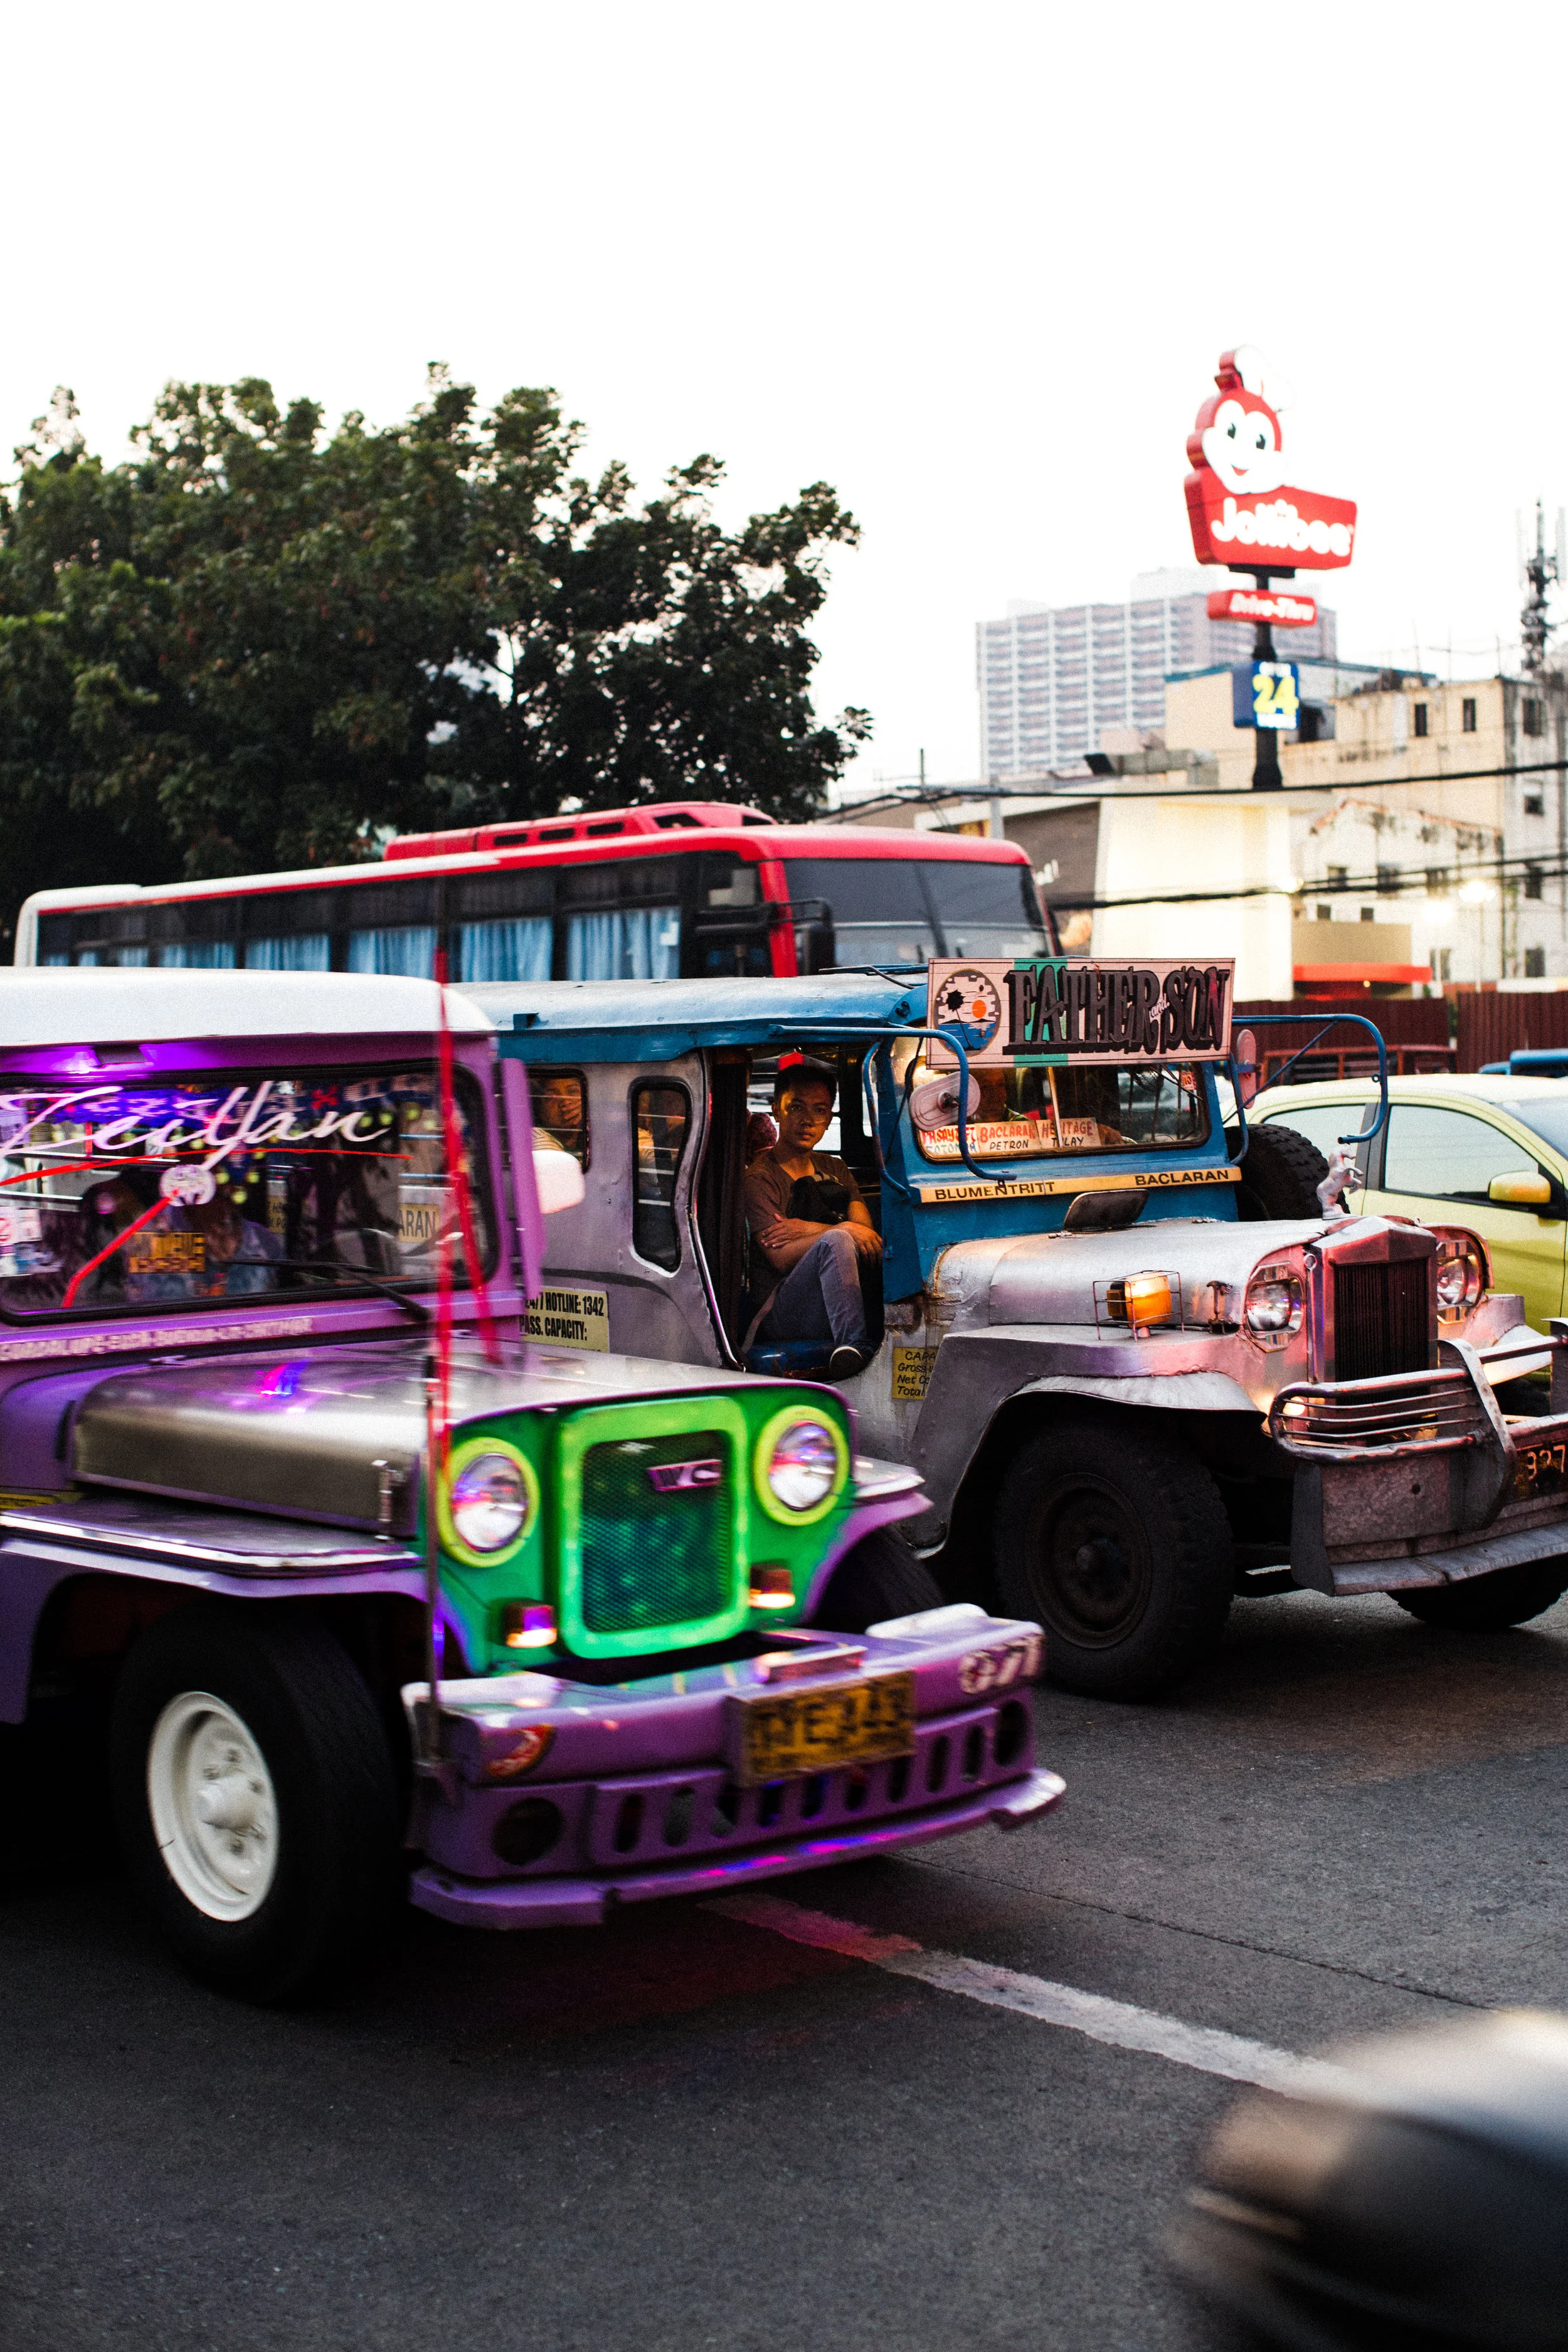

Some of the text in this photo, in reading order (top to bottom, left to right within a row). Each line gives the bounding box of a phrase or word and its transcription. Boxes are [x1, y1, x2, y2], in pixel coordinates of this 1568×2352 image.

[1253, 674, 1299, 716] 24
[1002, 965, 1160, 1055] FATHER
[1160, 966, 1230, 1054] SON
[979, 1124, 1036, 1143] BACLARAN
[1042, 1120, 1093, 1137] HEITAGE
[990, 1140, 1029, 1150] PETRON
[1051, 1136, 1084, 1147] TLAY
[1135, 1170, 1229, 1186] BACLARAN
[935, 1182, 1055, 1200] BLUMENTRITT
[545, 1292, 581, 1314] HOTLINE:
[583, 1295, 605, 1316] 1342
[519, 1315, 588, 1341] PASS. CAPACITY:
[898, 1362, 927, 1372] Gross
[897, 1374, 917, 1384] Net
[898, 1385, 925, 1396] Total
